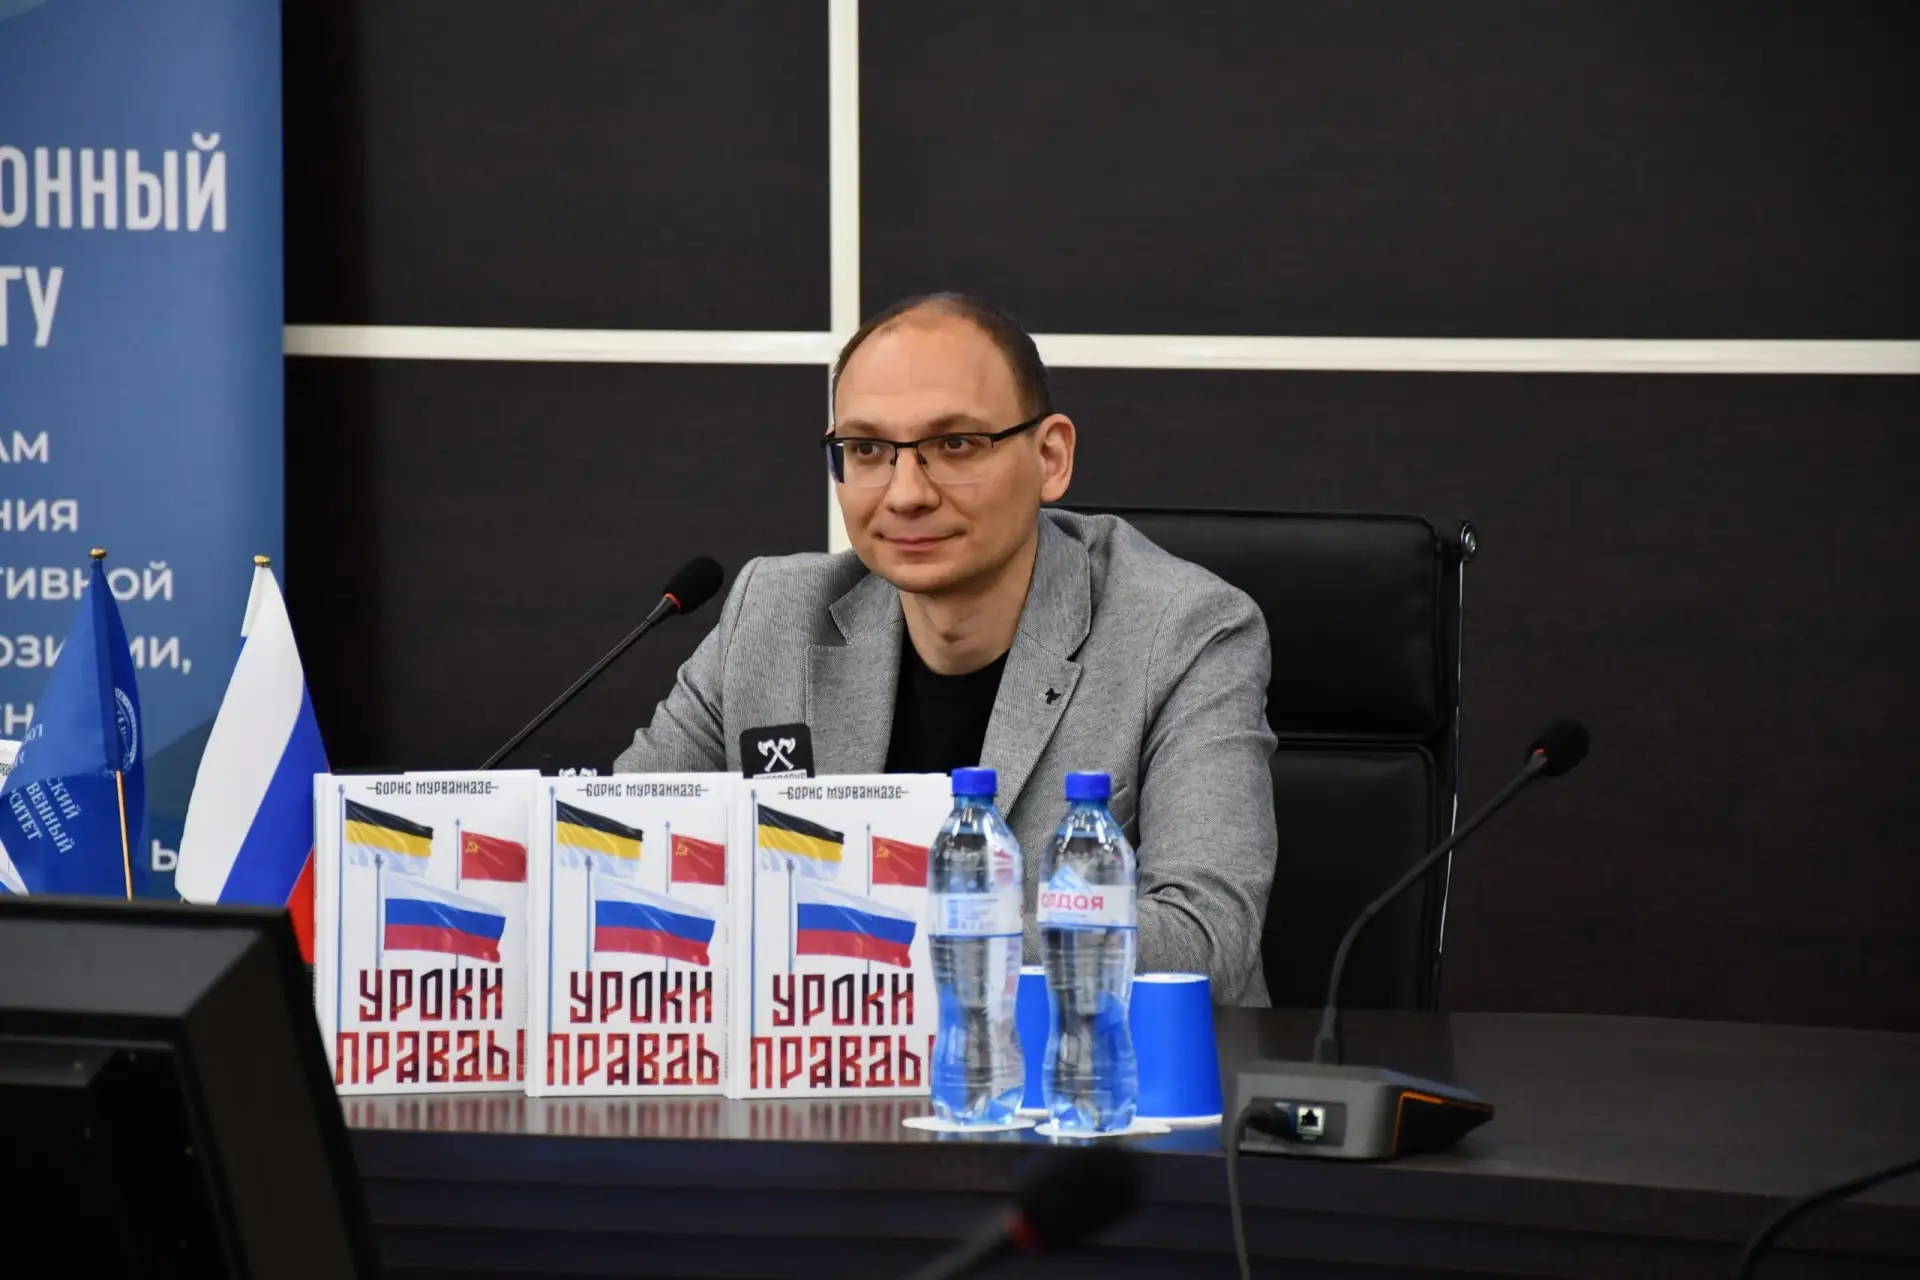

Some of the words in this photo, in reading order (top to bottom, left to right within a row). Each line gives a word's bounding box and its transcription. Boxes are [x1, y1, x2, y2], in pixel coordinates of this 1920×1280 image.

[0, 560, 174, 601] ИВНОЙ
[9, 787, 43, 841] СИТЕТ
[359, 968, 504, 1022] УРОКИ
[570, 971, 712, 1024] УРОКИ
[772, 973, 914, 1027] УРОКИ
